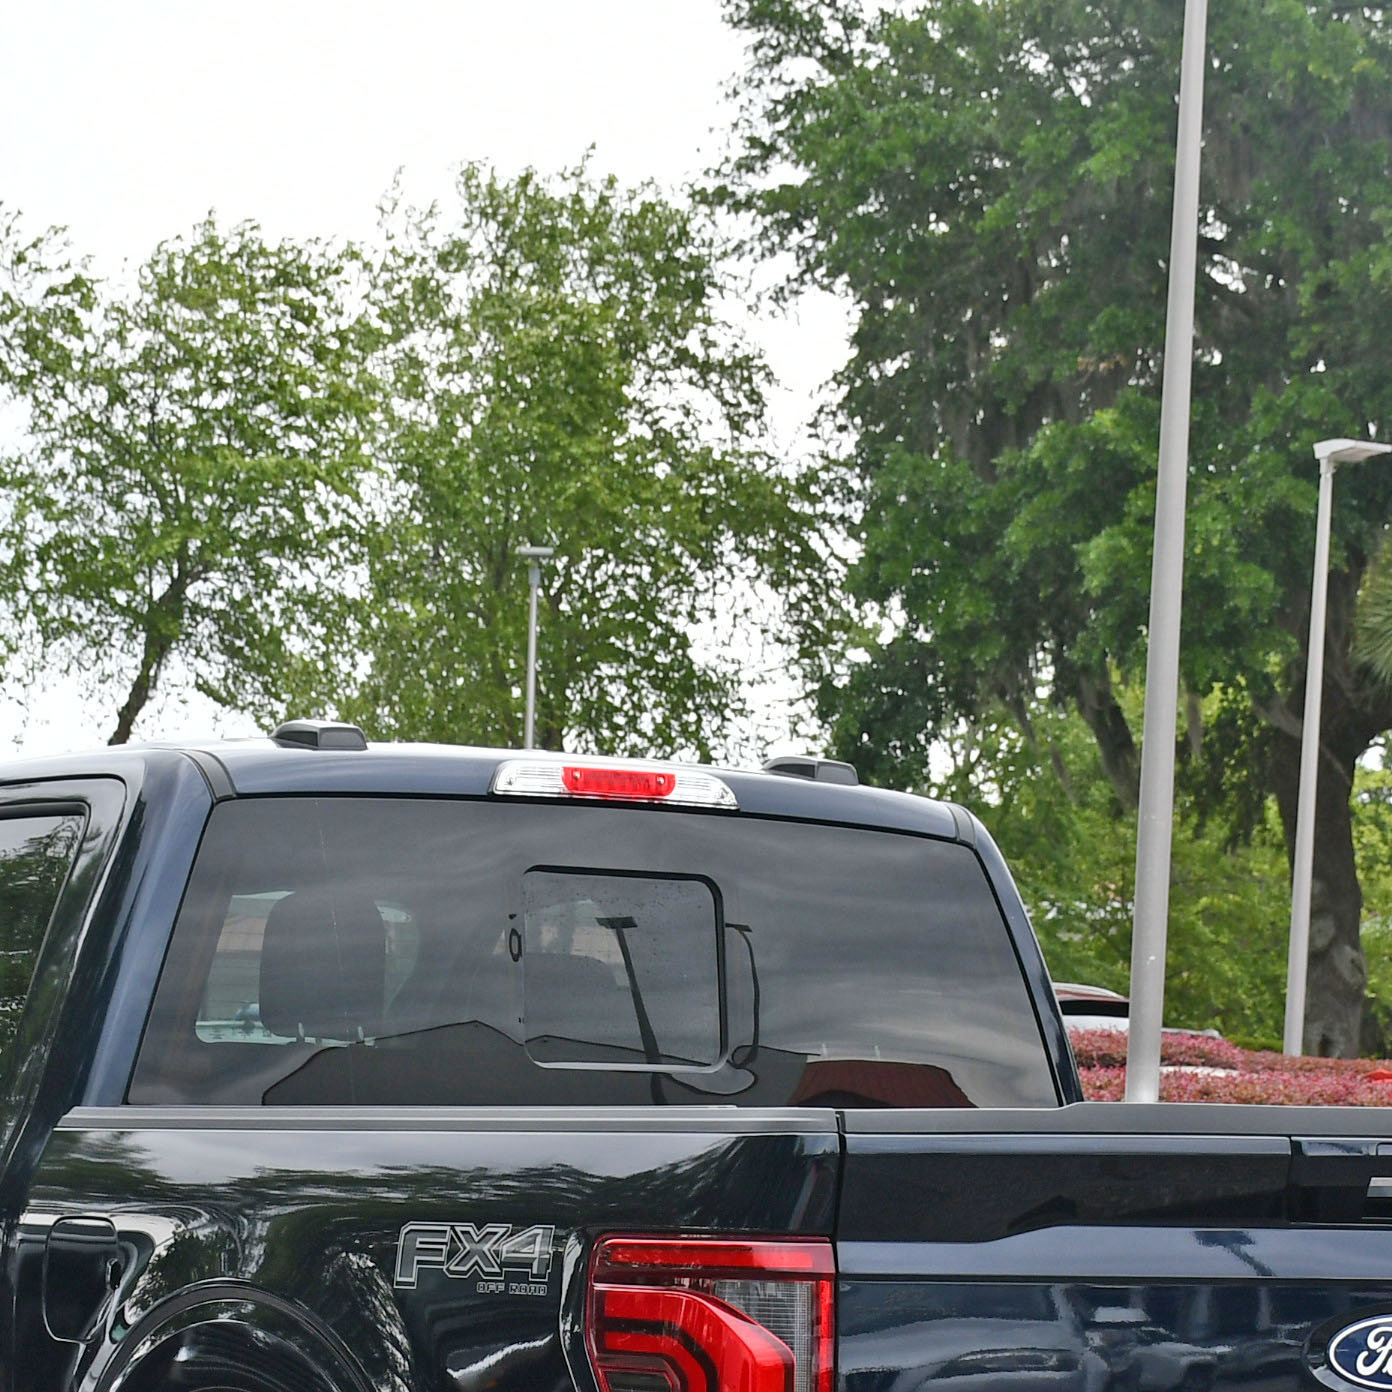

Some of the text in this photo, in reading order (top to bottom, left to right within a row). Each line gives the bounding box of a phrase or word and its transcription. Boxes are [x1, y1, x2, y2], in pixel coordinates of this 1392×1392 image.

[393, 1220, 556, 1289] FX4
[476, 1281, 548, 1297] OFF ROAD
